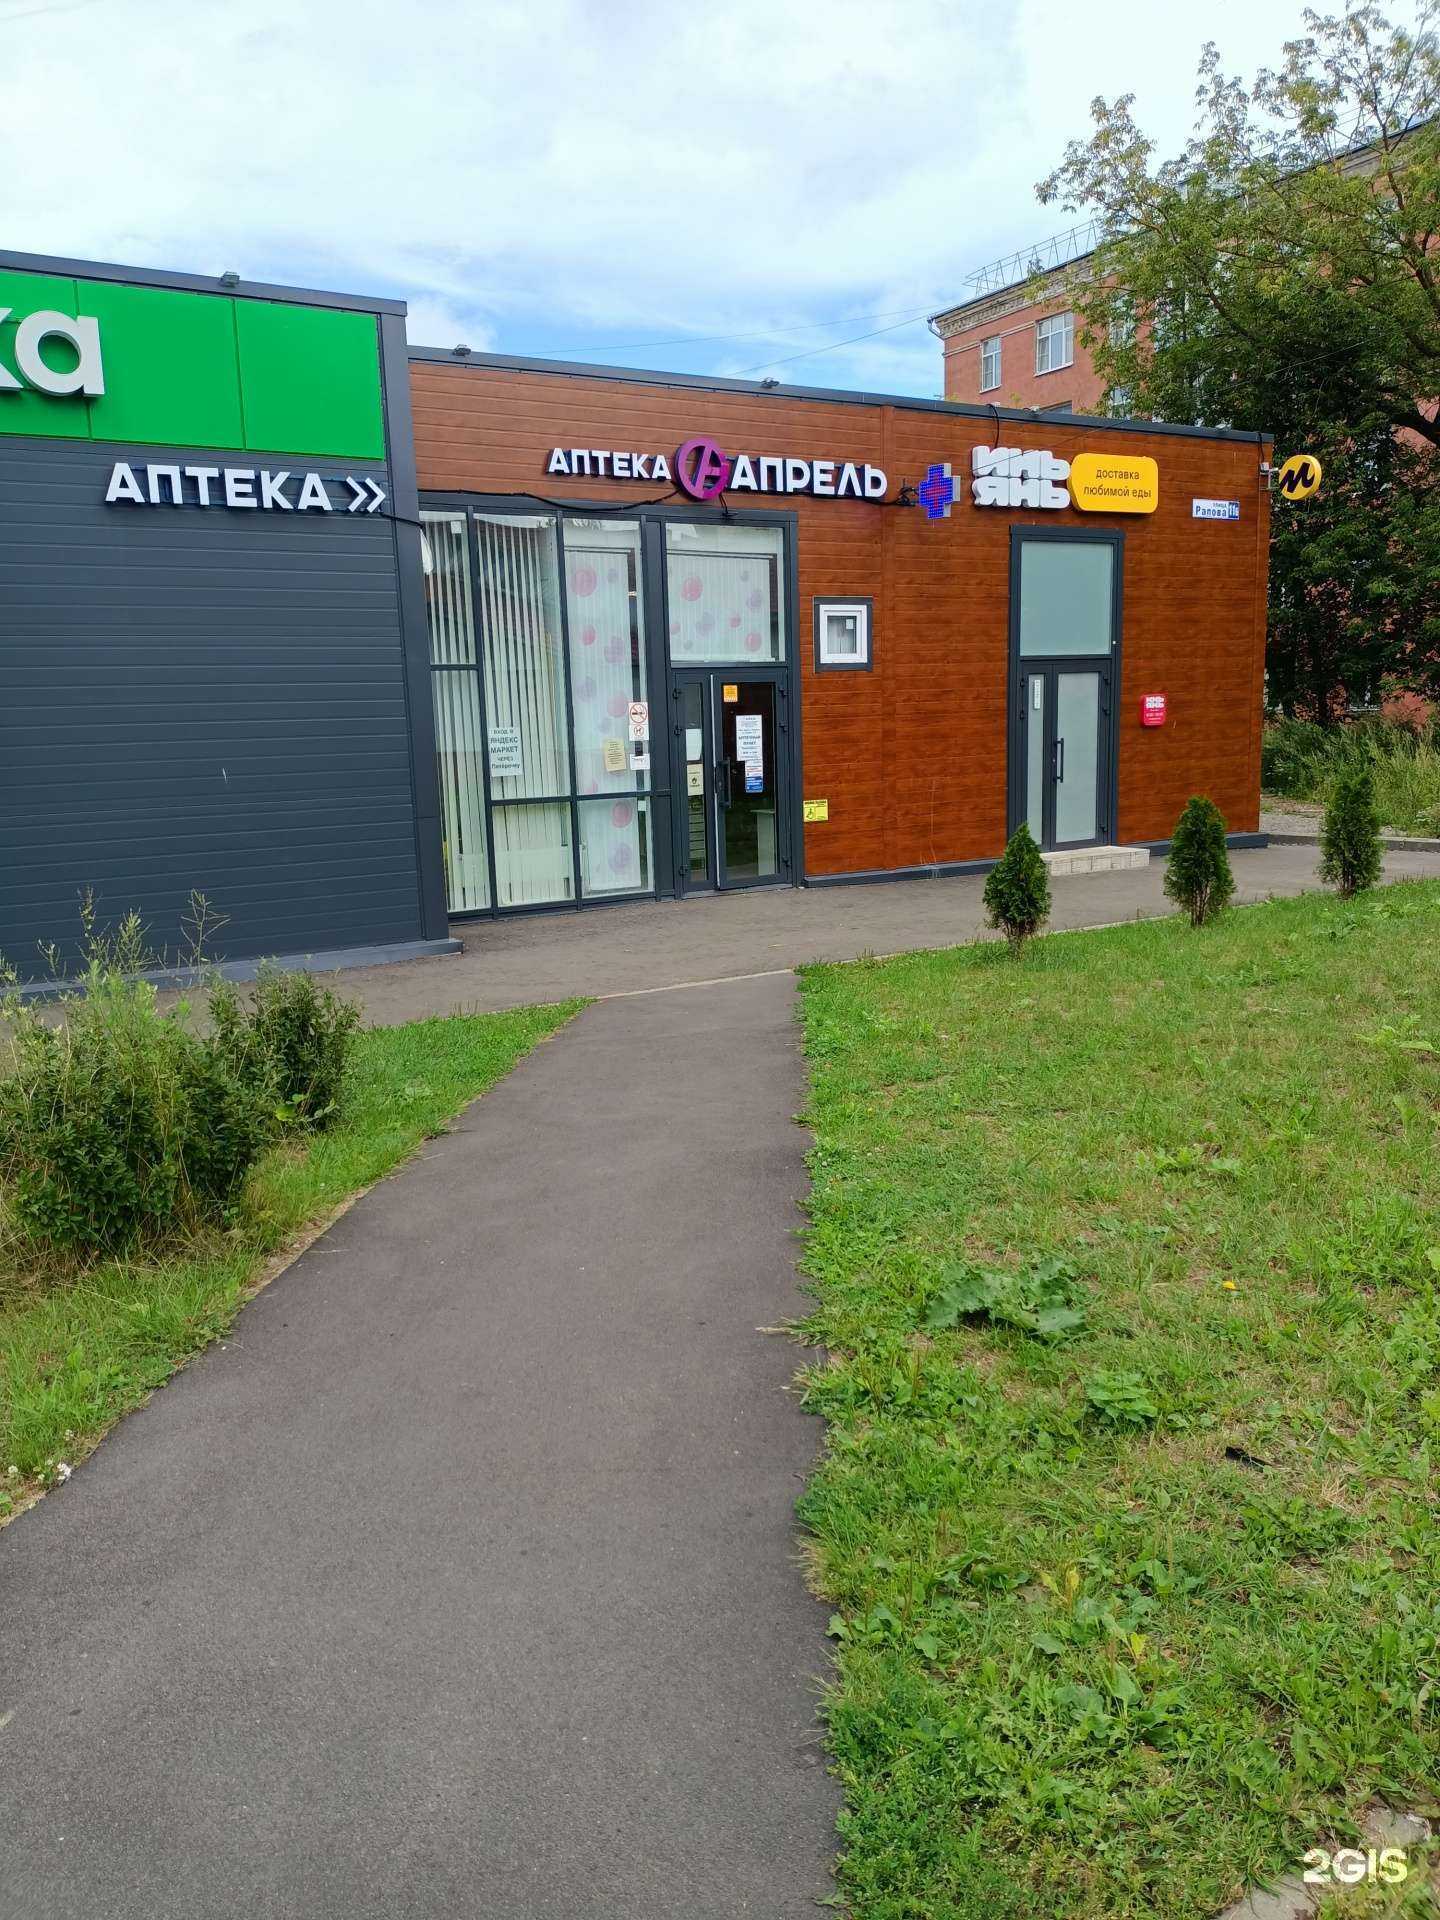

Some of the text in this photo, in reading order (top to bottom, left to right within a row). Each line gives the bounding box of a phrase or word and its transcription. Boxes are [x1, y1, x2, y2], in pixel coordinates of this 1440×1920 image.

[548, 447, 889, 498] АПТЕКА АПРЕЛЬ
[1095, 468, 1141, 480] доставка
[105, 462, 333, 512] АПТЕКА
[971, 476, 1072, 509] ЯНЬ
[1083, 485, 1152, 500] любимой еды
[1195, 505, 1227, 517] Рапова
[490, 746, 518, 754] МАРКЕТ
